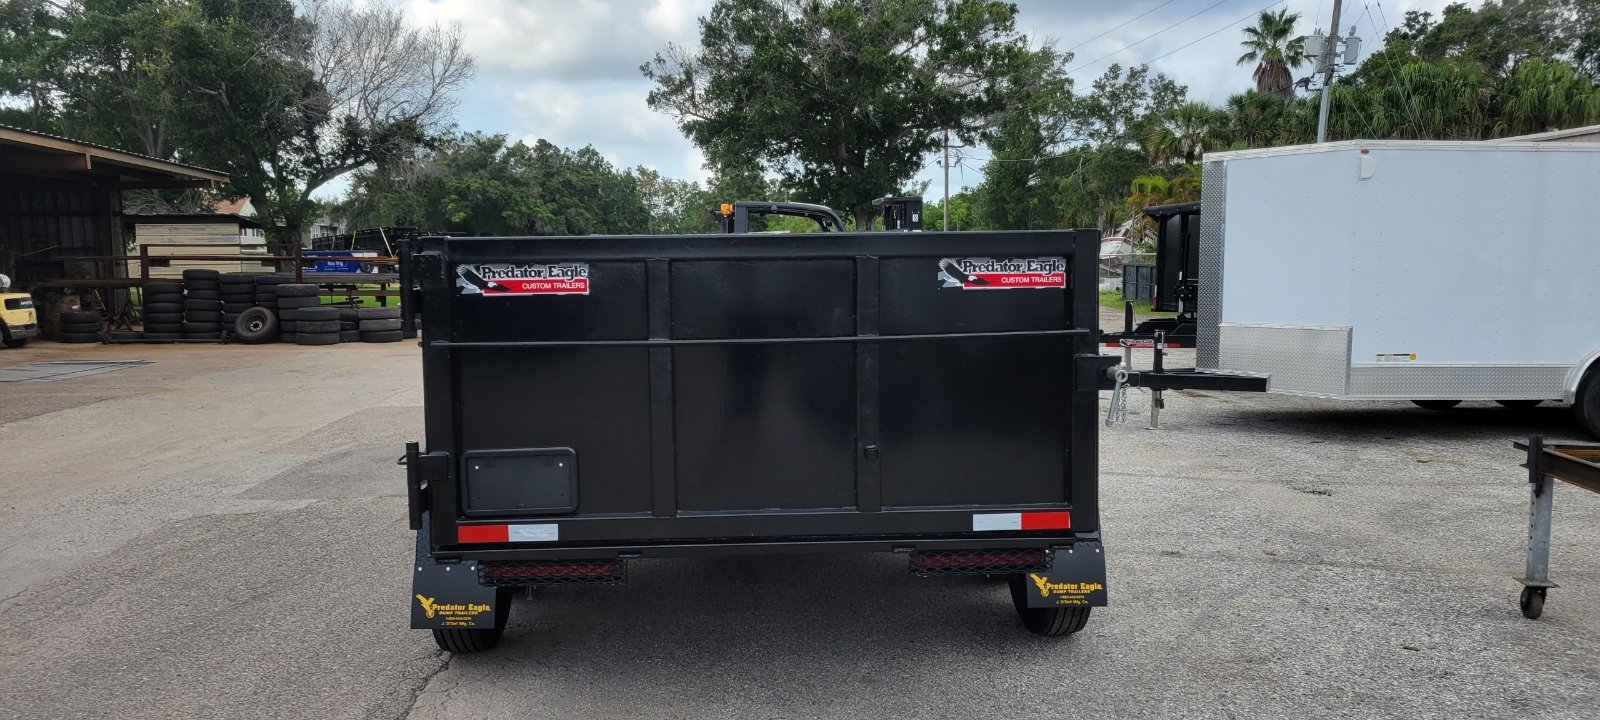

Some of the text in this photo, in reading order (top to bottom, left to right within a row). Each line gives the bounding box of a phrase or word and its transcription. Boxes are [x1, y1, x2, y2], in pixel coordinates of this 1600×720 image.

[481, 264, 588, 281] Predator Eagle
[962, 259, 1066, 275] Predator Eagle
[1001, 276, 1030, 284] CUSTOM
